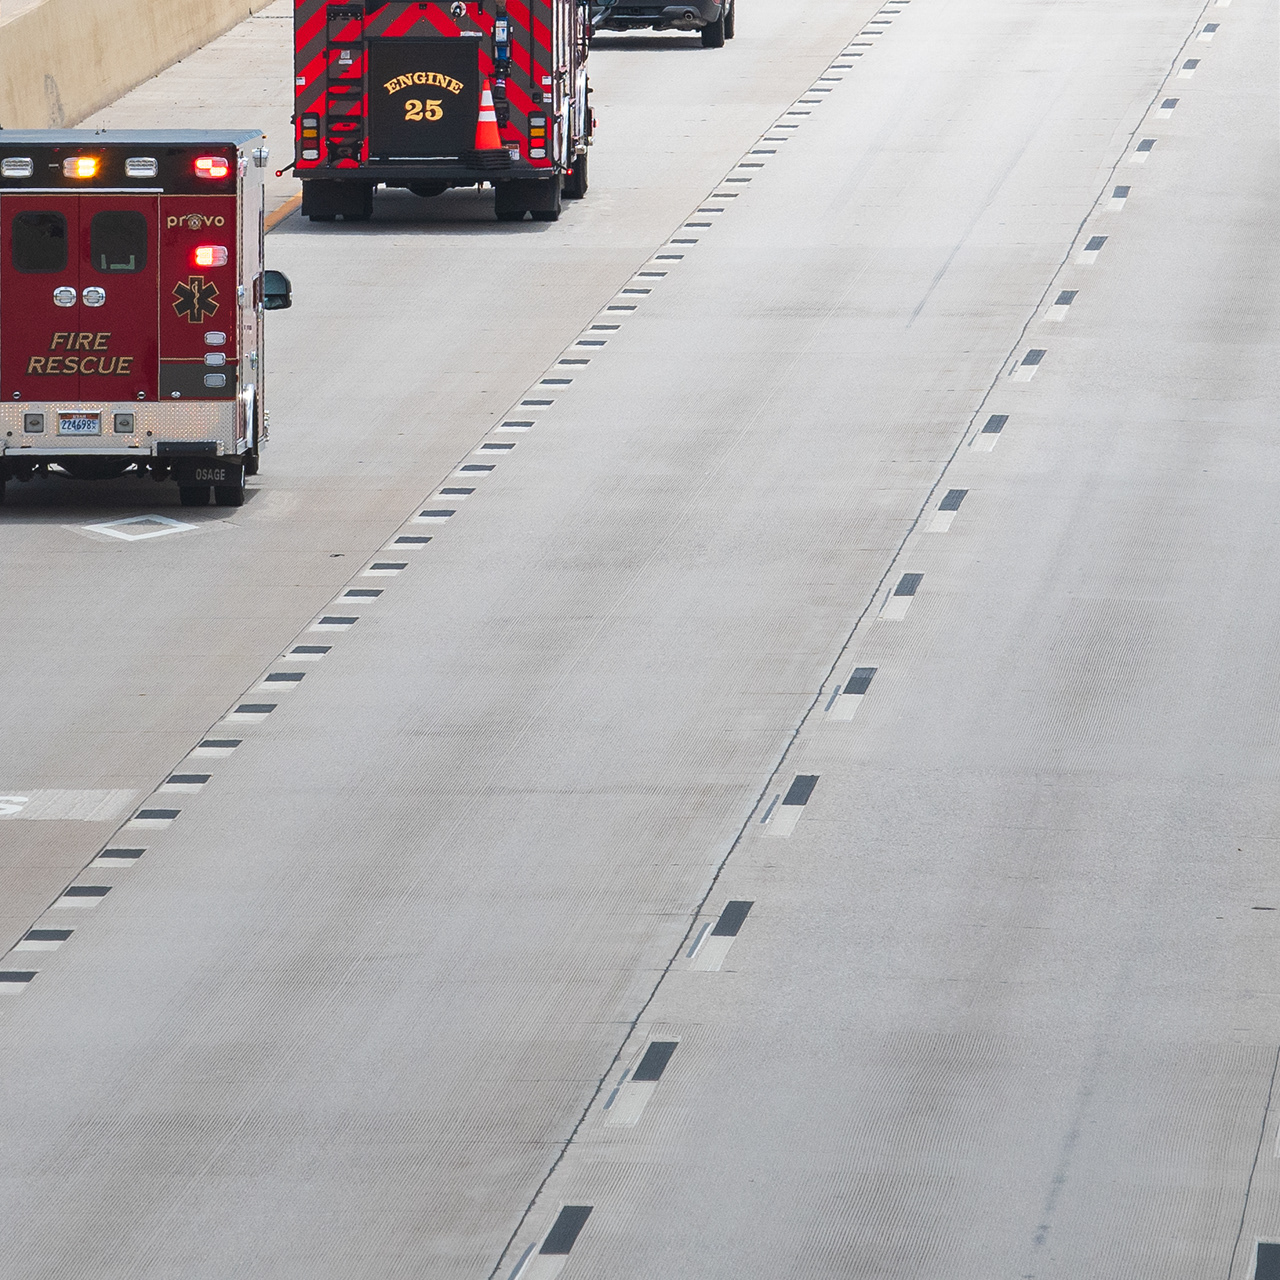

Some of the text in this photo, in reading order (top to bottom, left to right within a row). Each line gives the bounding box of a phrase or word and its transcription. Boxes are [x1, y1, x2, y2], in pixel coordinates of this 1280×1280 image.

[383, 72, 464, 95] ENGINE
[405, 99, 444, 122] 25
[50, 332, 111, 350] FIRE
[27, 356, 134, 374] RESCUE
[196, 469, 226, 480] OSAGE
